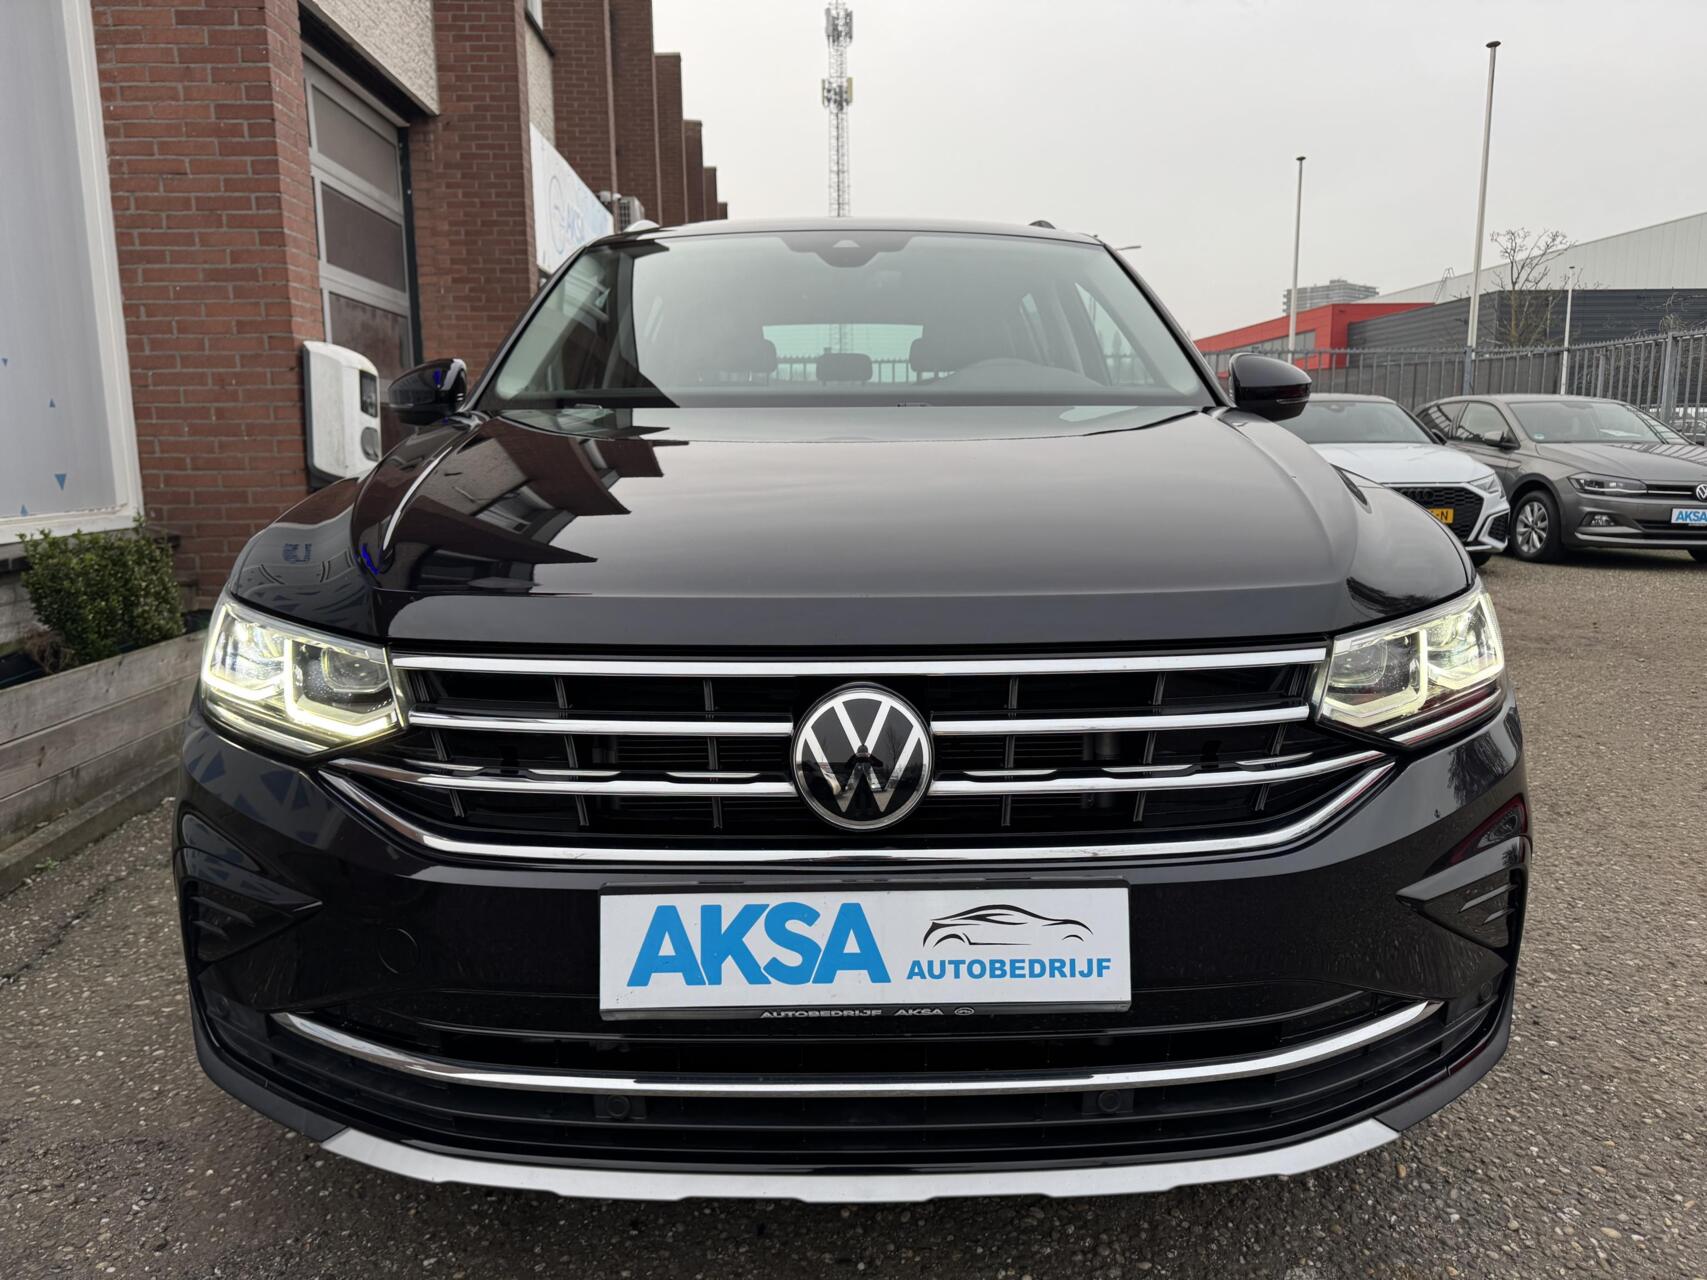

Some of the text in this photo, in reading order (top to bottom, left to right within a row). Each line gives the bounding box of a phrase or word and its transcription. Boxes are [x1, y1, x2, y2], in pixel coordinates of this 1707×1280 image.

[1675, 510, 1707, 522] AKSA
[627, 902, 891, 987] AKSA
[907, 958, 1111, 980] AUTOBEDRIJF
[760, 1008, 944, 1018] AUTOBEDRIJF AKSA
